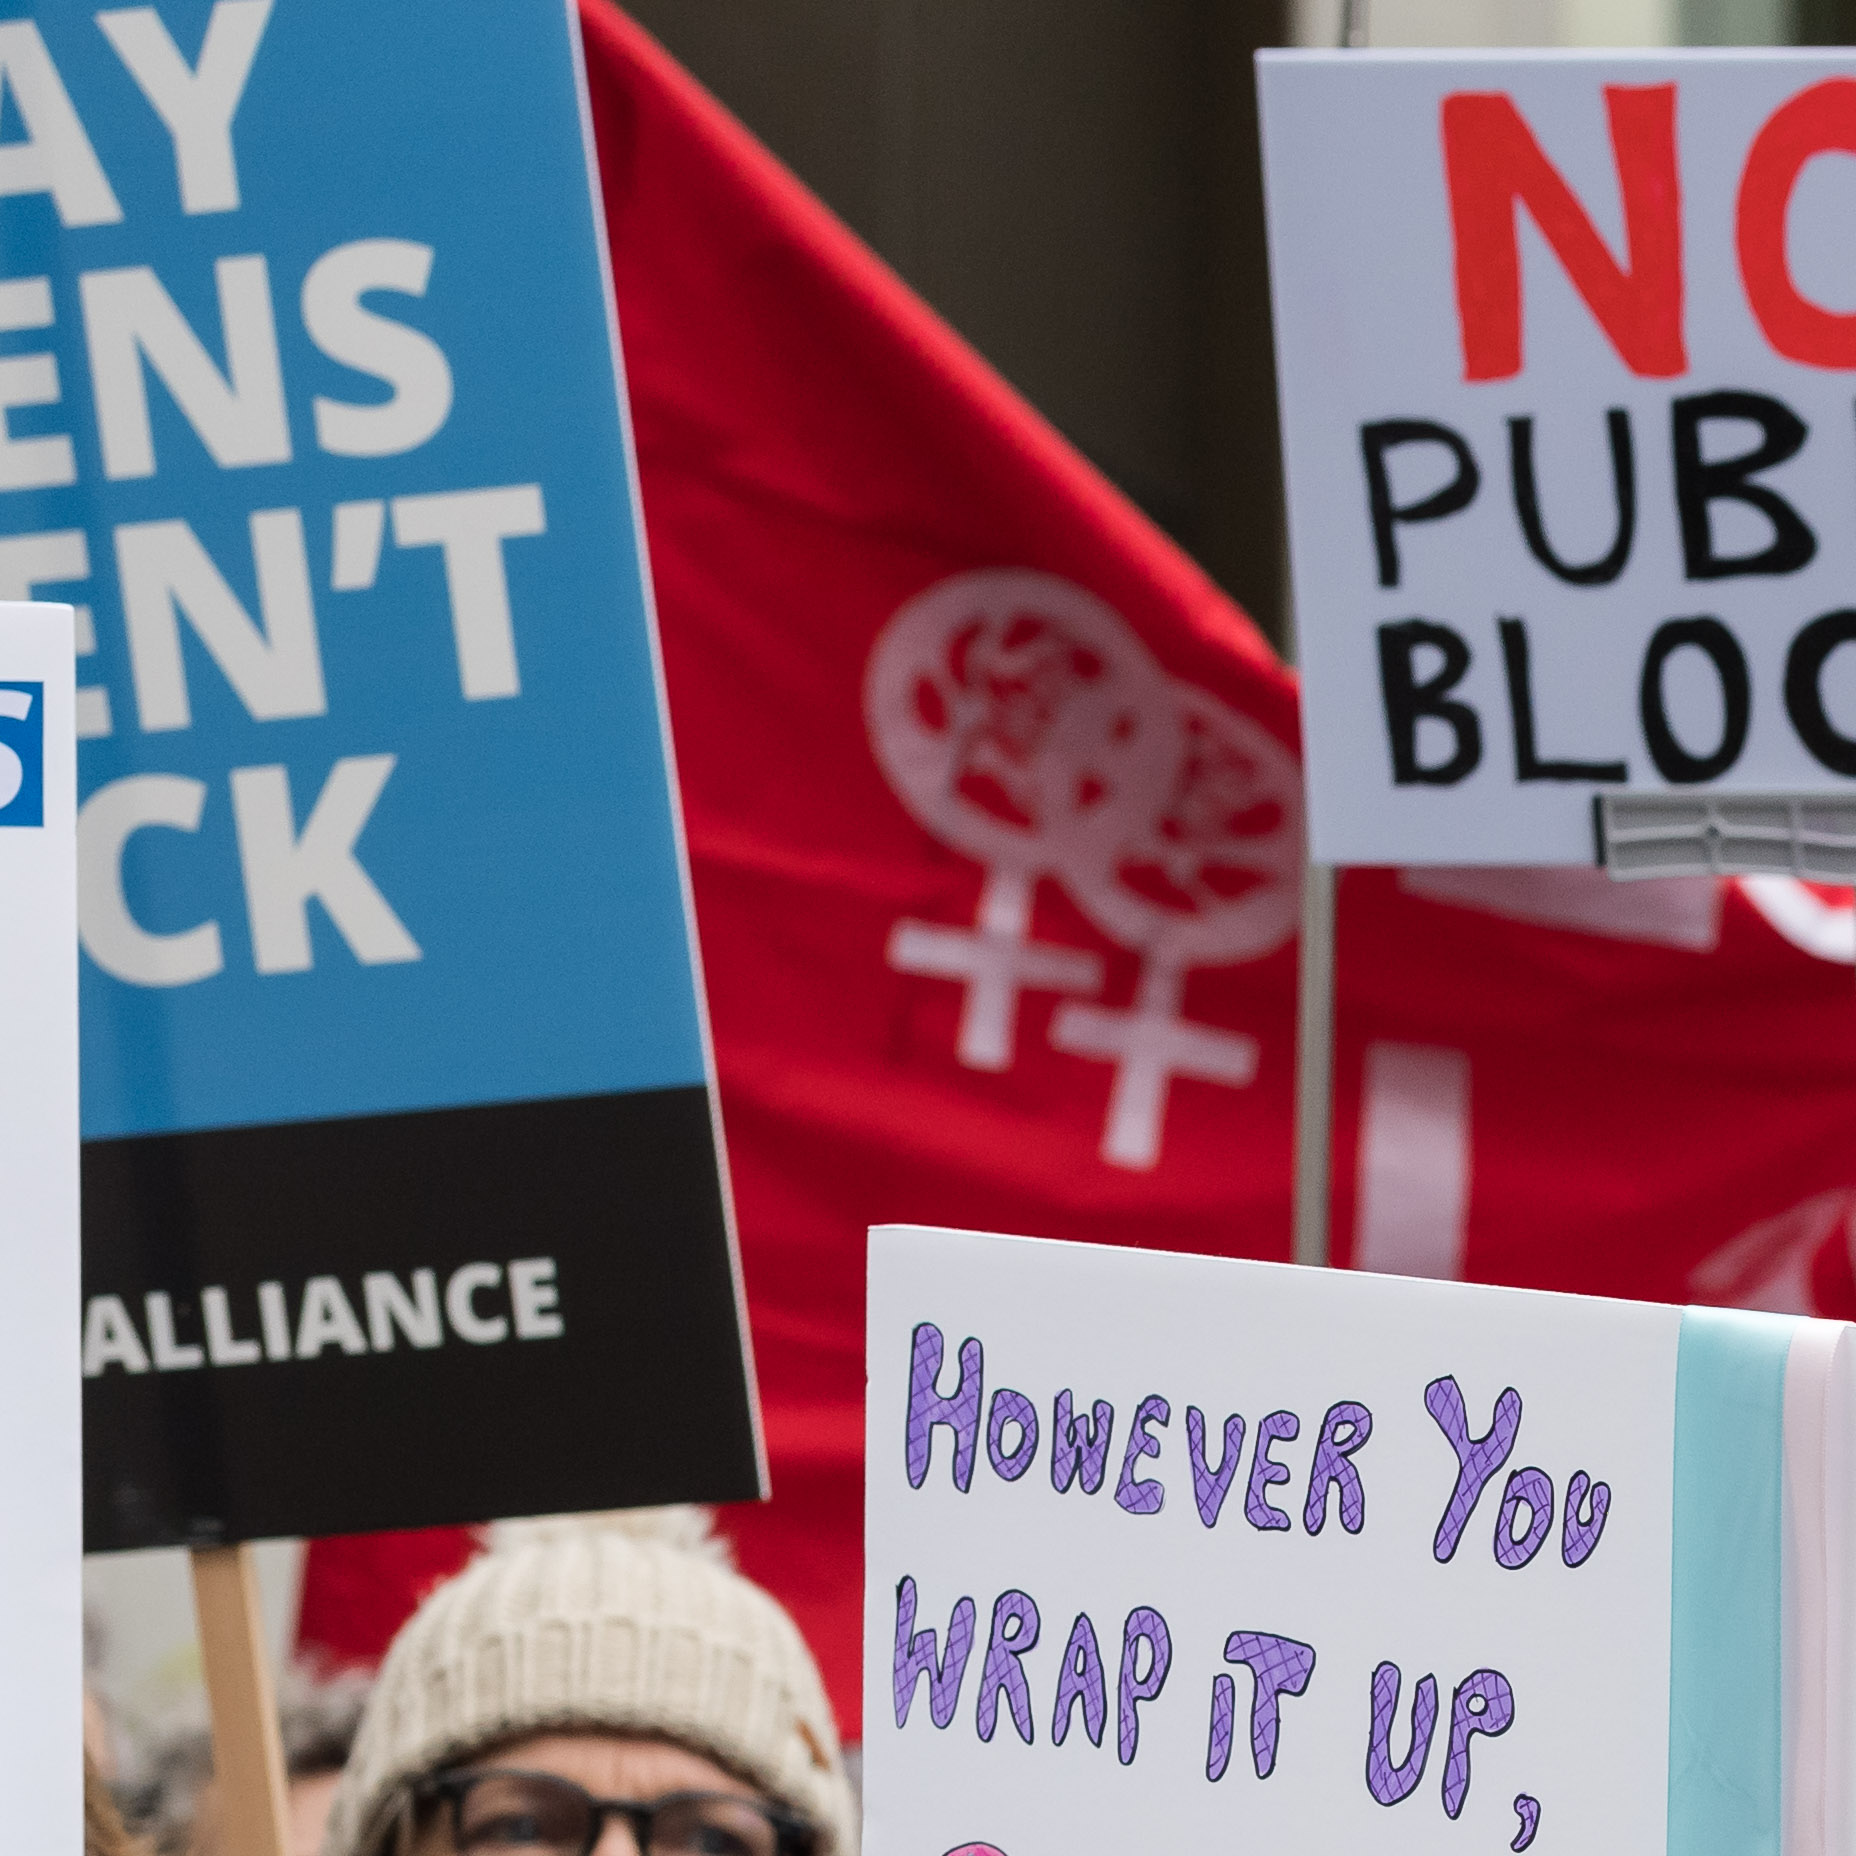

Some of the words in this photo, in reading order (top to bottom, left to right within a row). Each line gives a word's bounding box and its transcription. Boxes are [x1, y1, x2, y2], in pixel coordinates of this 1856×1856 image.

[0, 0, 275, 228] AY
[0, 237, 455, 492] ENS
[0, 483, 547, 738] EN'T
[76, 754, 423, 988] CK
[83, 1257, 565, 1377] ALLIANCE
[904, 1321, 1374, 1535] HOWEVER
[892, 1575, 1173, 1767] WRAP
[1365, 1660, 1542, 1854] UP,
